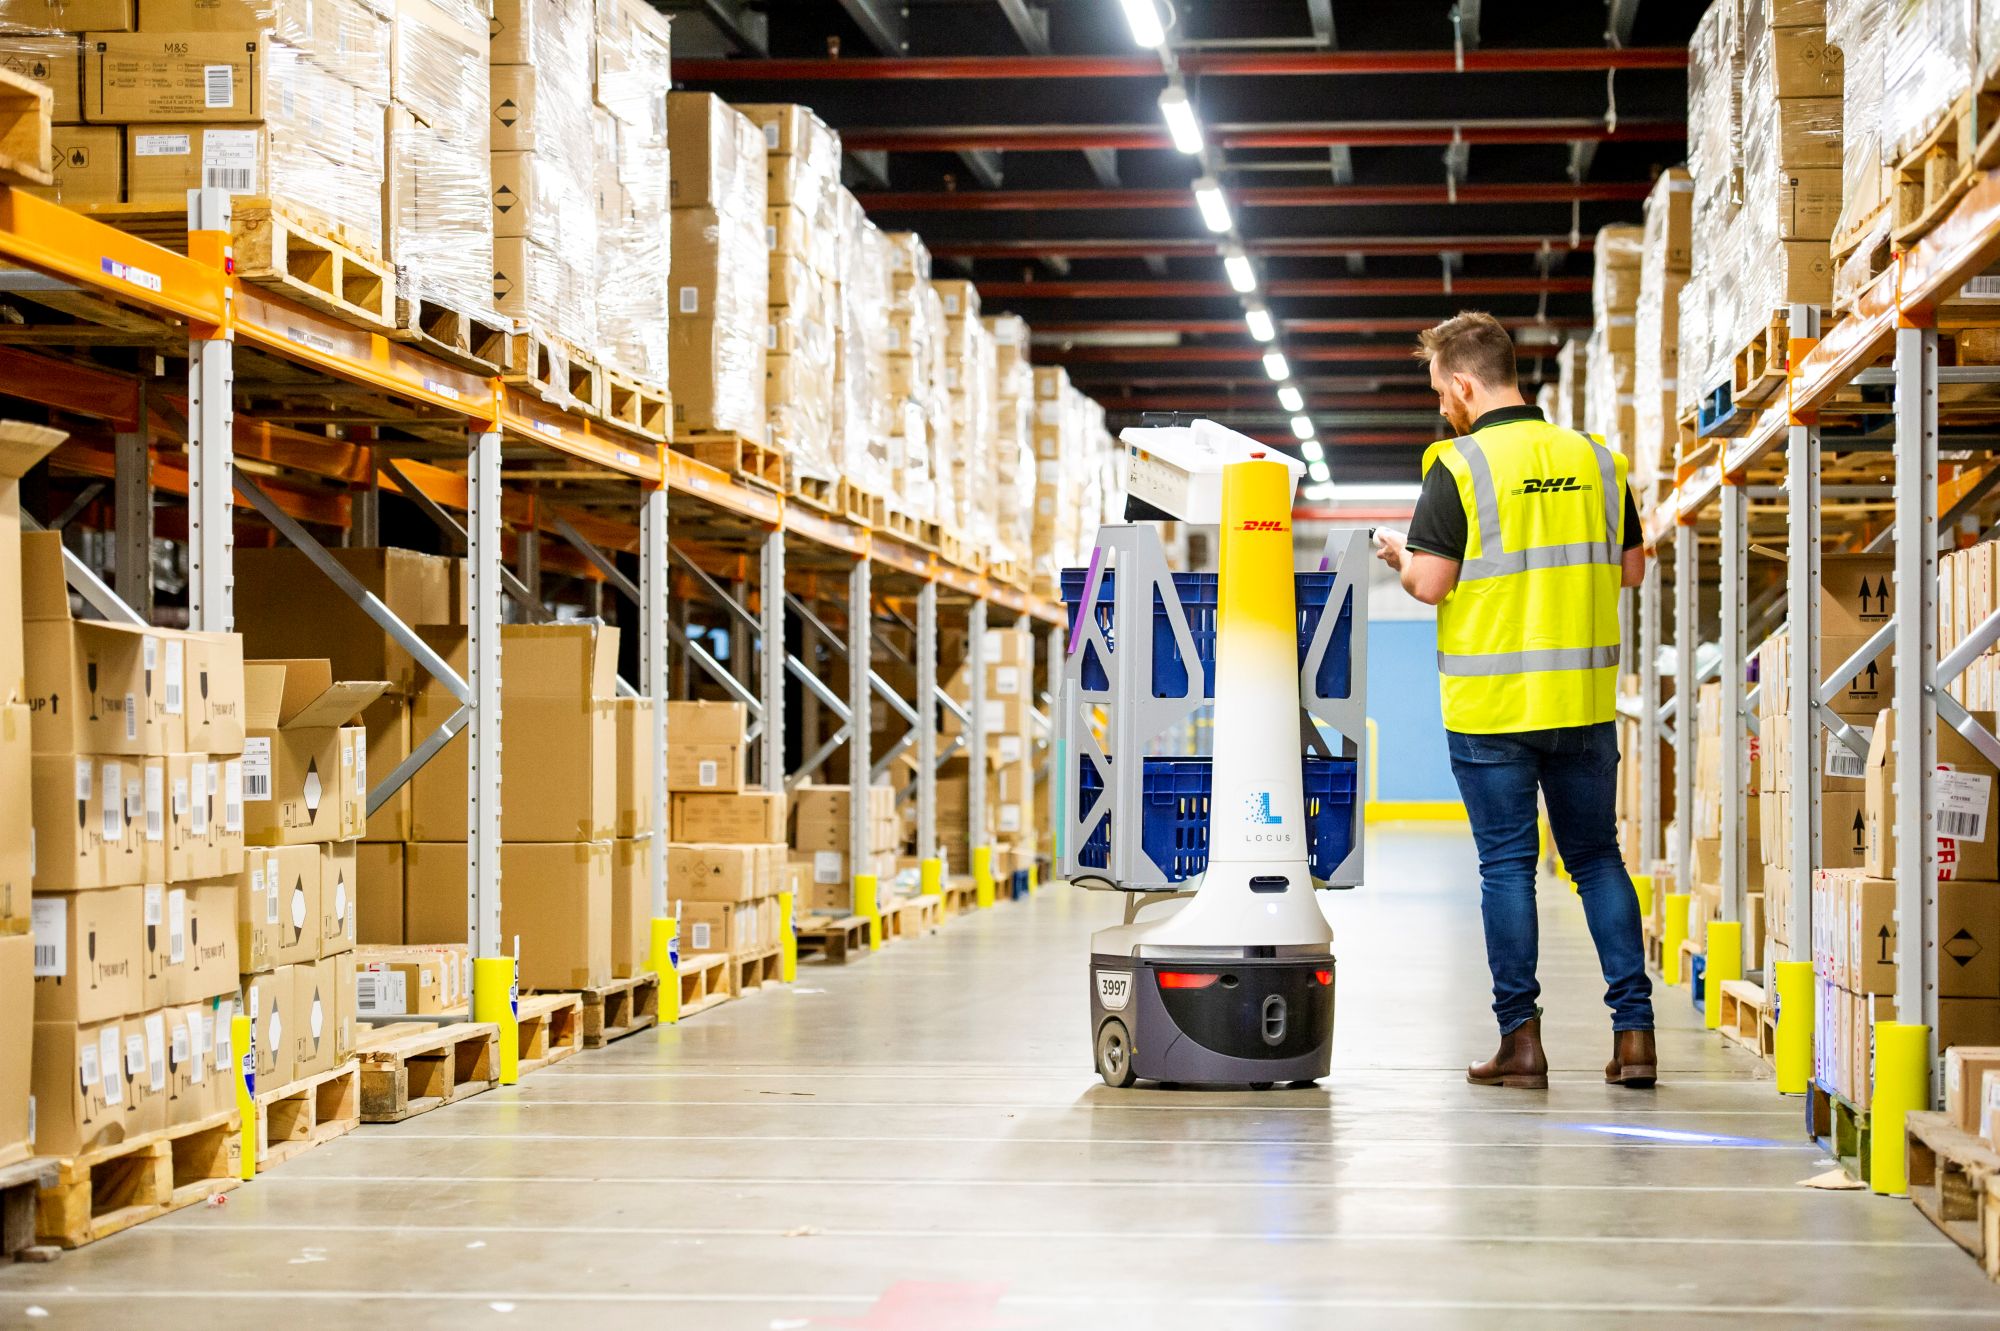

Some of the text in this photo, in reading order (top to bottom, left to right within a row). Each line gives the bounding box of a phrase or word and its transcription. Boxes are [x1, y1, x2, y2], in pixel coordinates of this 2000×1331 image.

[164, 42, 189, 54] M&S
[1522, 477, 1582, 494] DHL
[1243, 520, 1283, 531] DHL
[29, 698, 46, 712] UP
[1246, 834, 1291, 842] LOCUS
[1102, 979, 1127, 996] 3997
